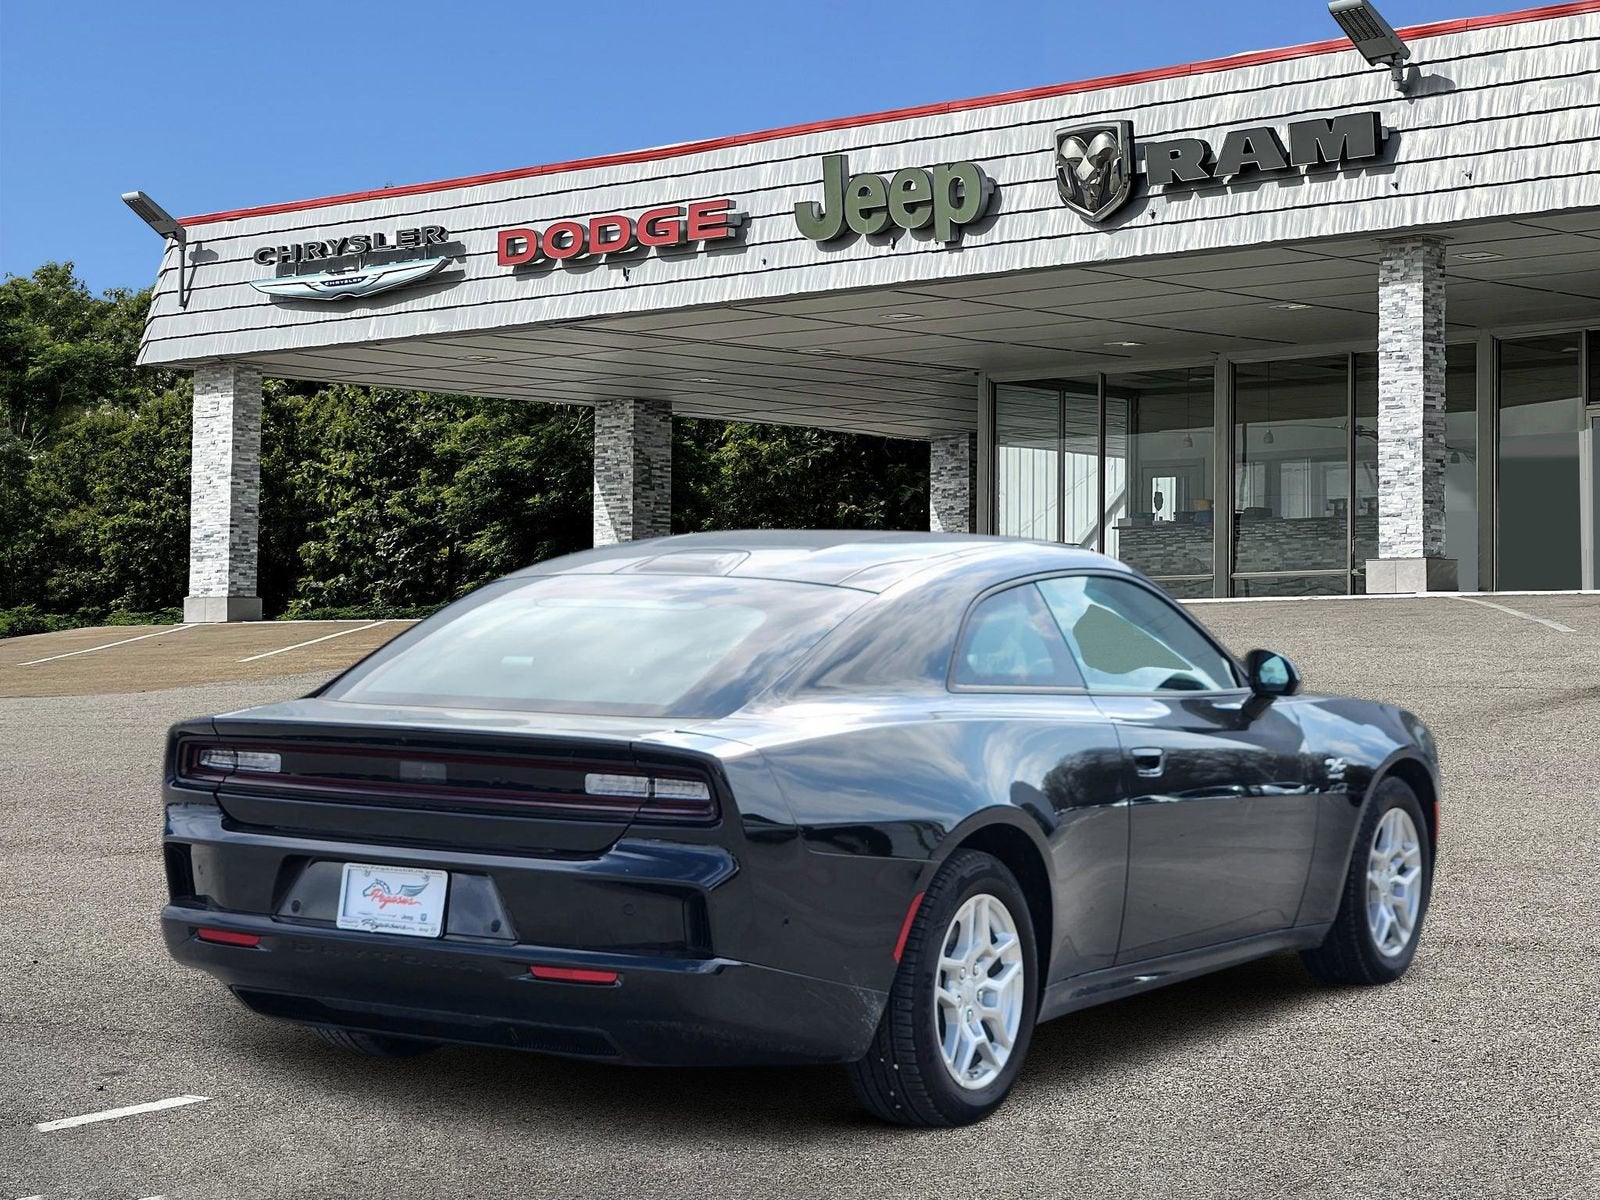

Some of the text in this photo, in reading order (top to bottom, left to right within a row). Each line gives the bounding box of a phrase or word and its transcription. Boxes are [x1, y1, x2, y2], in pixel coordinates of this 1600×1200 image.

[1144, 111, 1379, 186] RAM
[794, 154, 988, 242] Jeep
[253, 224, 449, 267] CHRYSLER
[497, 199, 736, 267] DODGE
[370, 887, 422, 909] Pegasus
